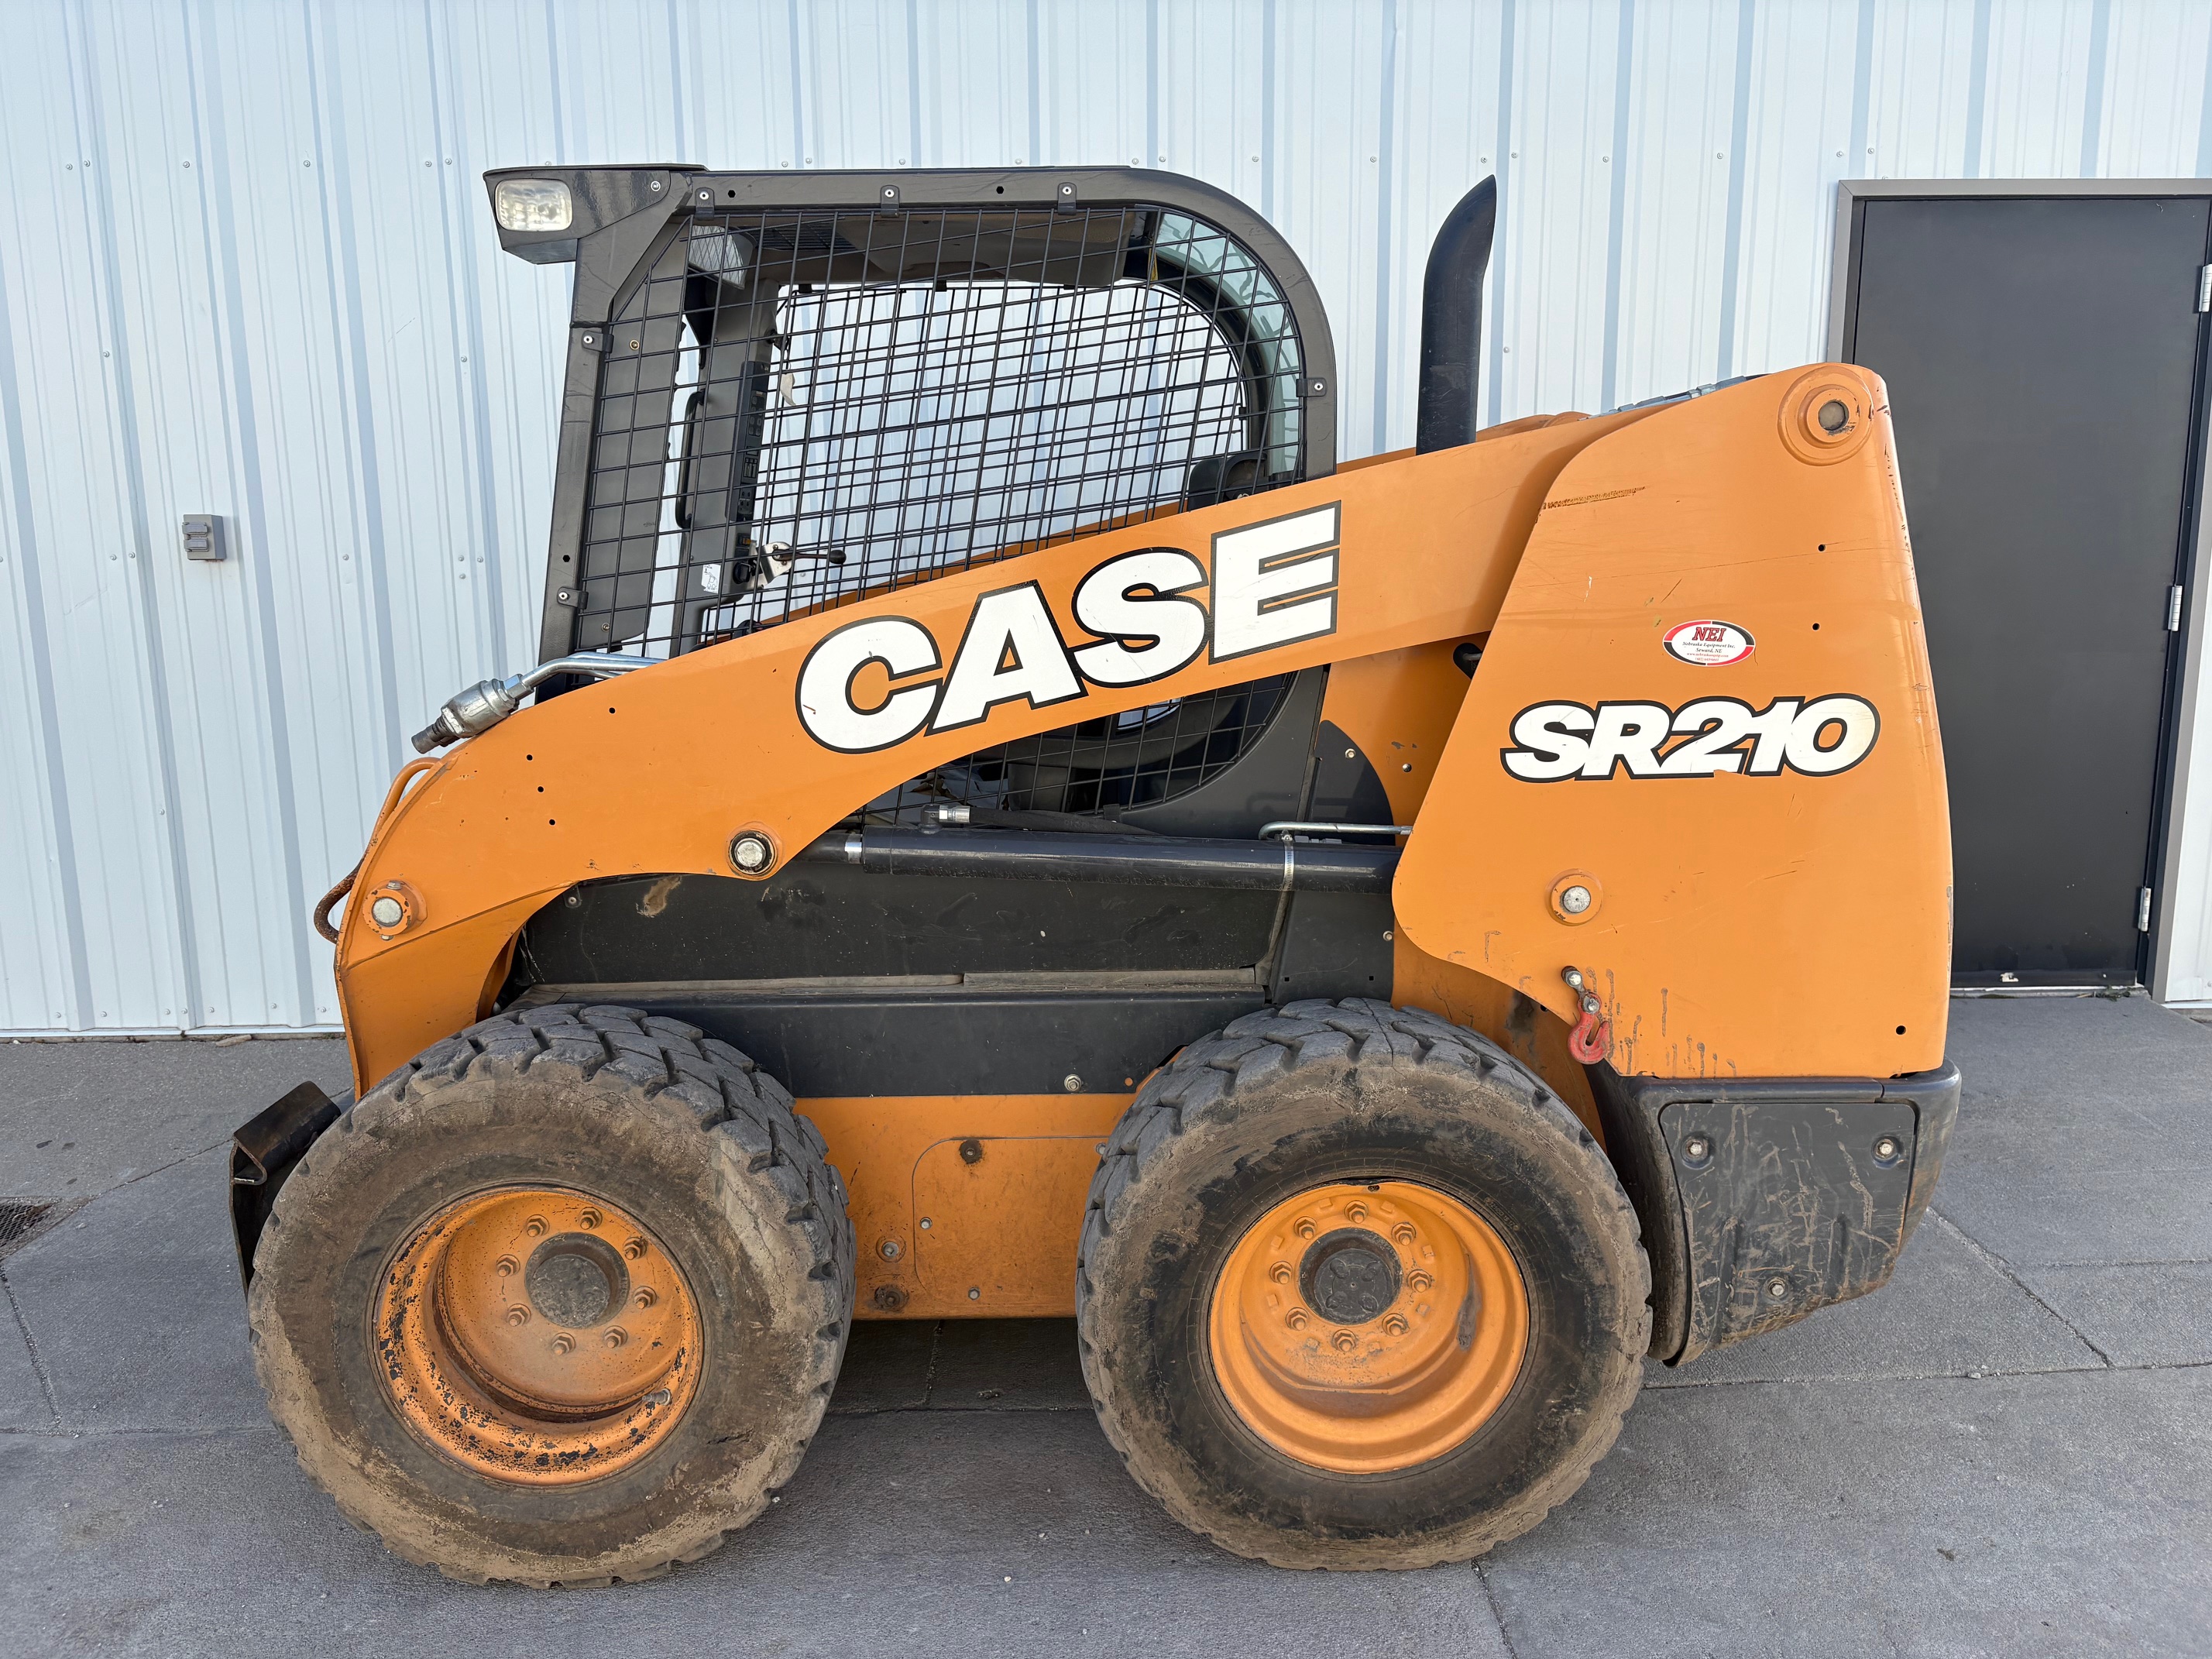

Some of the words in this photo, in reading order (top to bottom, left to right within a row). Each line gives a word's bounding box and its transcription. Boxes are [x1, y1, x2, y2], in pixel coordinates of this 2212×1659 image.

[795, 500, 1341, 754] CASE
[1692, 627, 1727, 642] NEI
[1500, 693, 1881, 783] SR210
